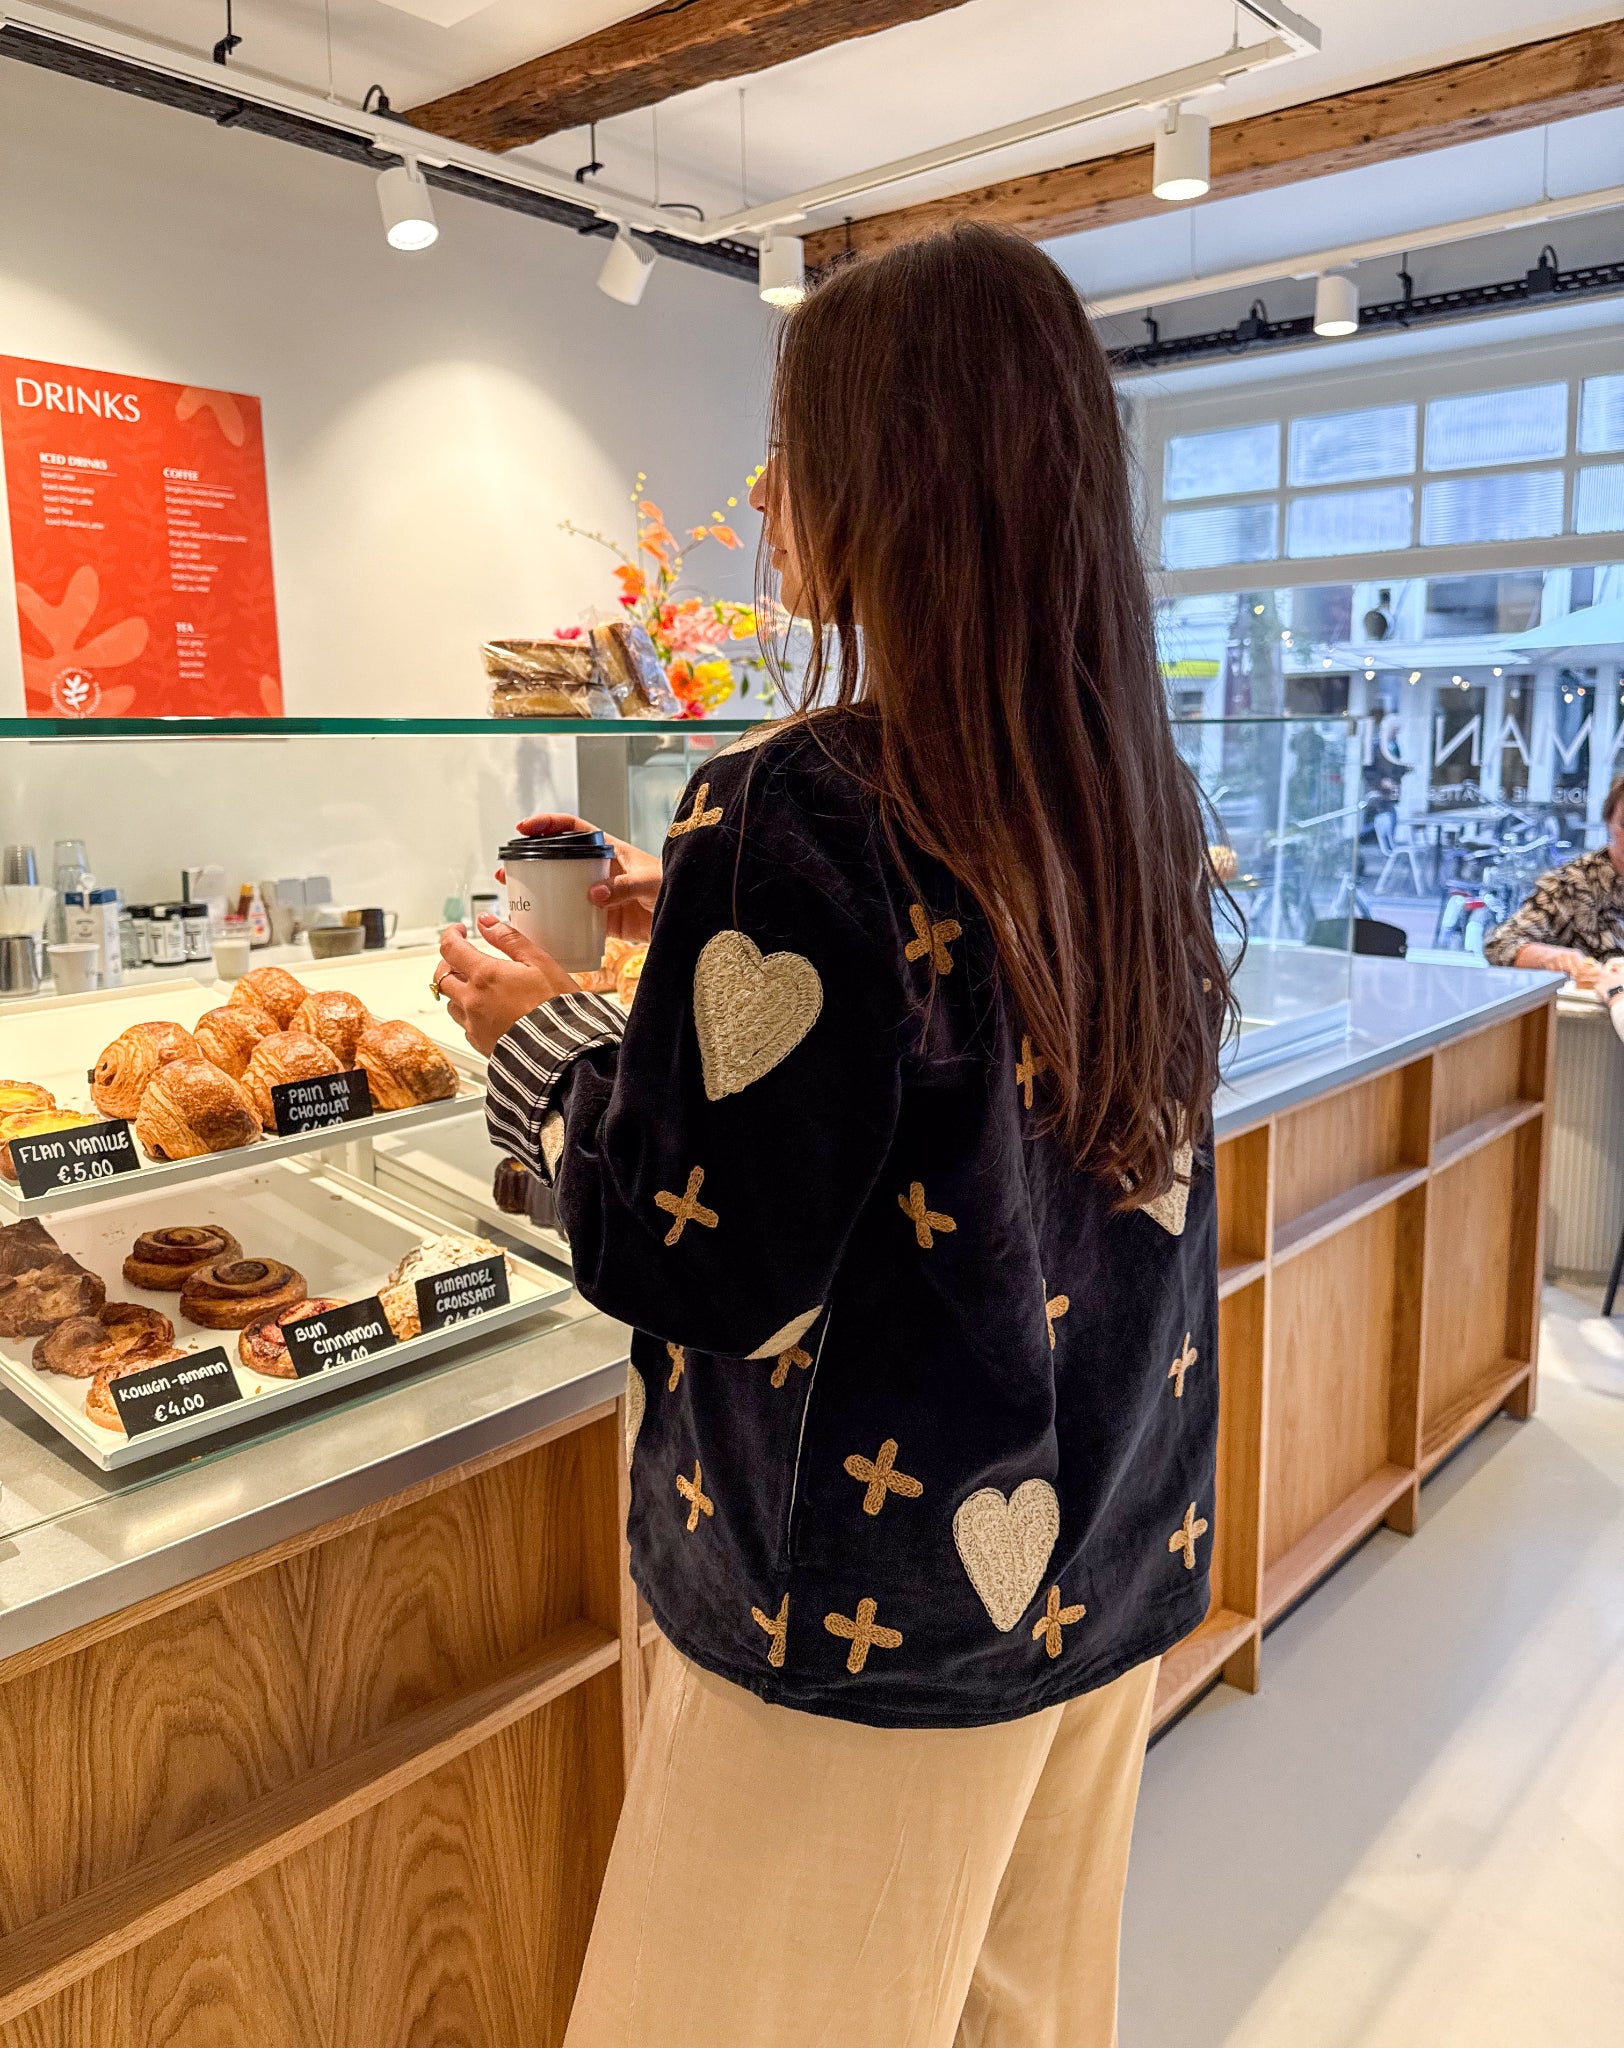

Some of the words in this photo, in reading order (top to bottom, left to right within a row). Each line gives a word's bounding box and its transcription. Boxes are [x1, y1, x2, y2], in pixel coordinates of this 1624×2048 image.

[16, 377, 141, 422] DRINKS
[39, 452, 66, 466] ICED
[67, 455, 108, 471] DRINKS
[162, 467, 199, 481] COFFEE
[175, 621, 195, 633] TEA
[288, 1085, 324, 1104] PAIN
[329, 1079, 350, 1097] AU
[289, 1097, 349, 1121] CHOCOLAT
[19, 1142, 66, 1164] FLAN
[68, 1131, 129, 1157] VANILLE
[434, 1268, 492, 1295] AMANDEL
[436, 1284, 496, 1313] CROISSANT
